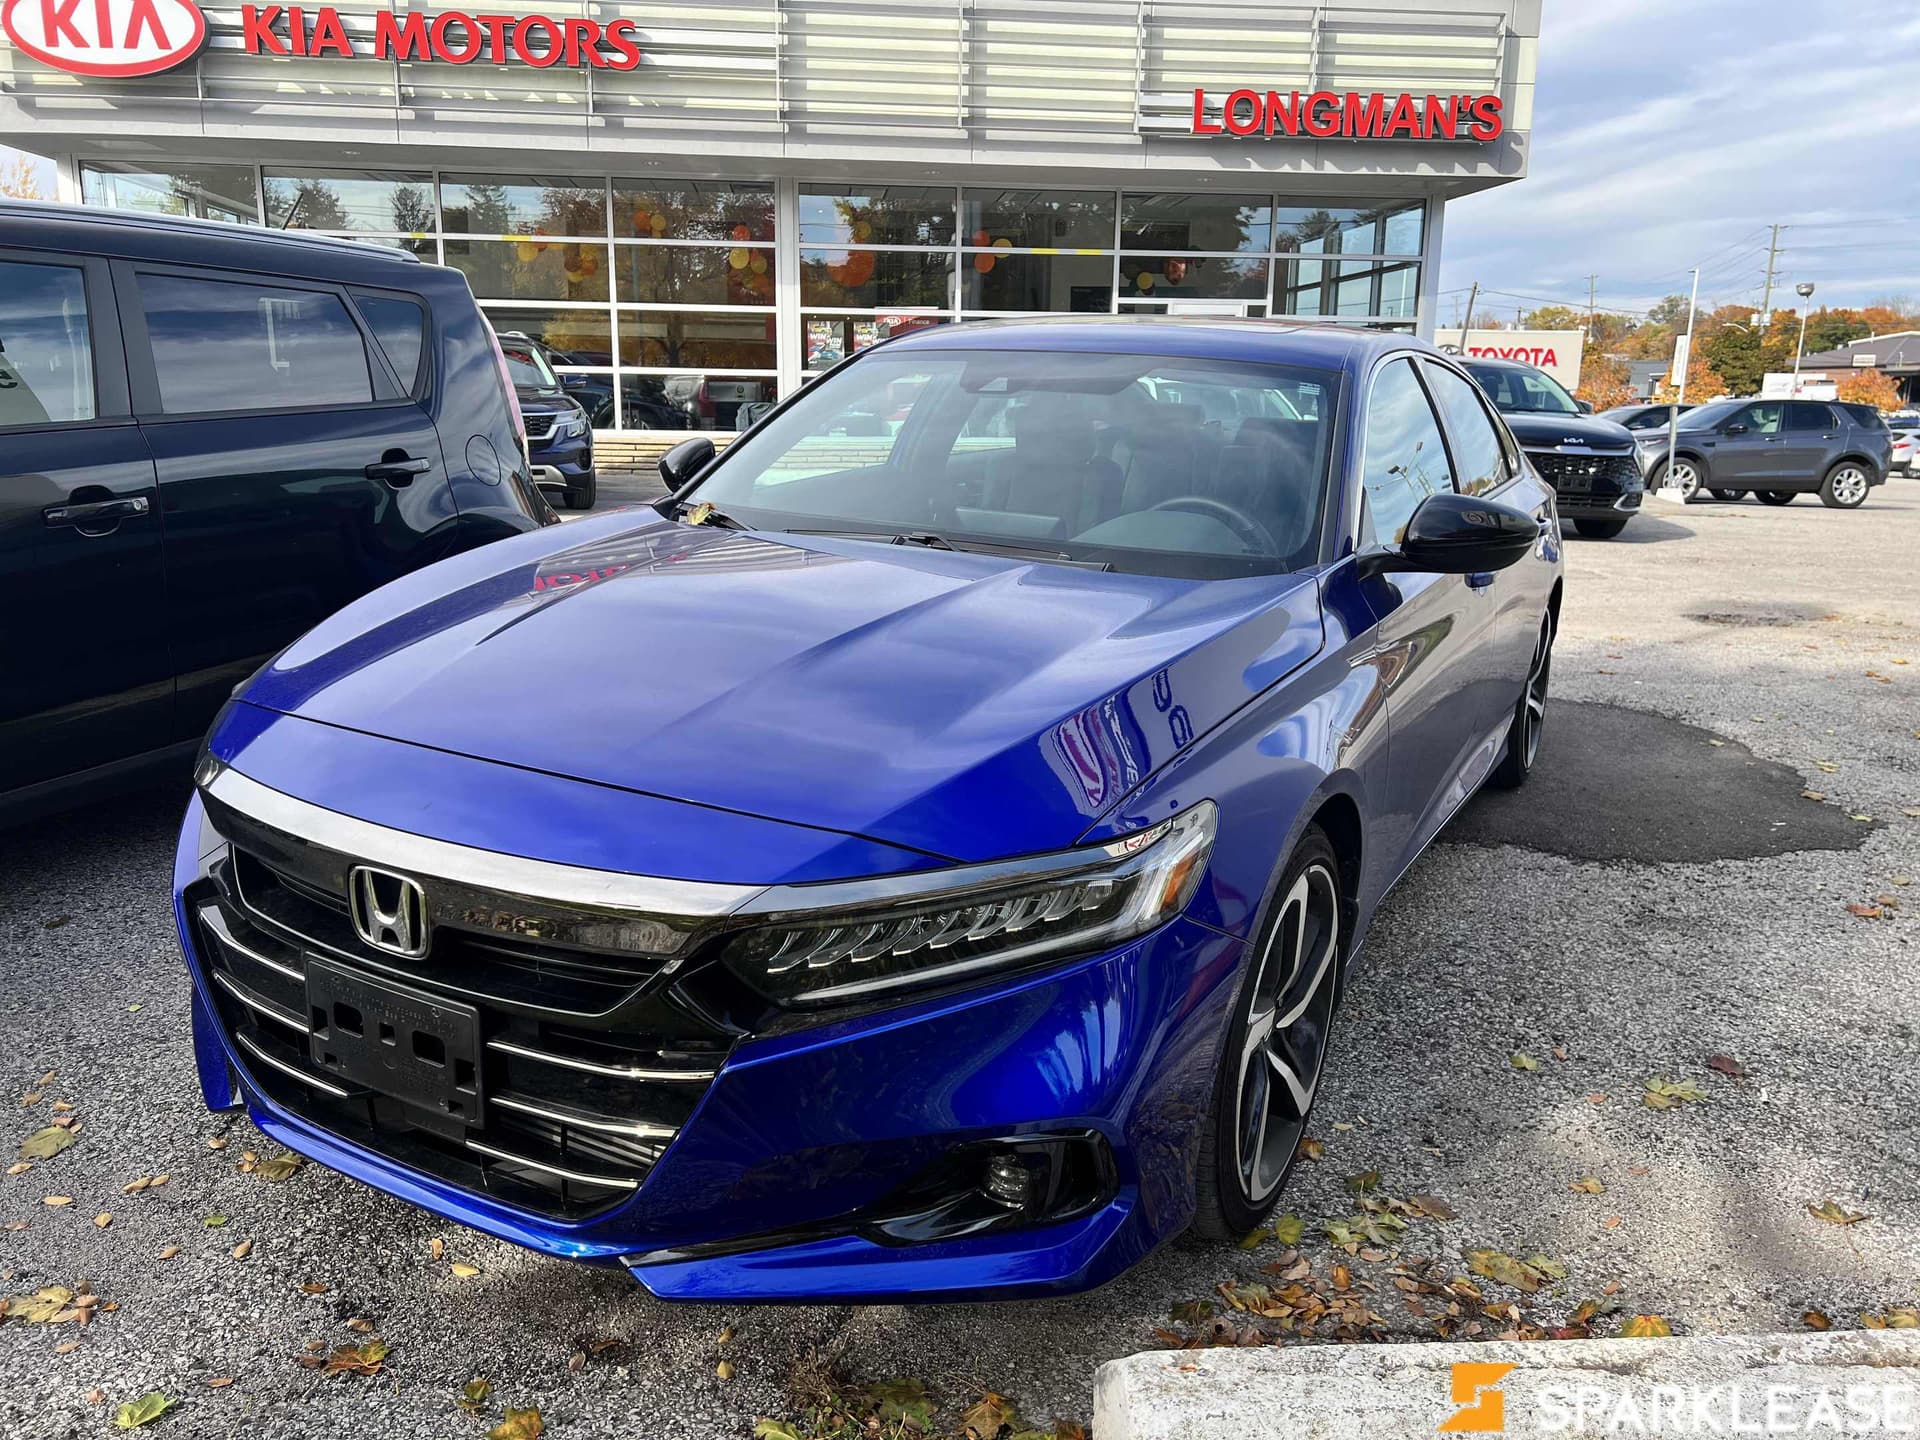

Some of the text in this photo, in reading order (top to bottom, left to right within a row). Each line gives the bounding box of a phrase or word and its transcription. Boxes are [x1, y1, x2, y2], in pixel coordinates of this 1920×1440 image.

[41, 0, 172, 50] KIA
[241, 4, 641, 70] KIA MOTORS
[1192, 88, 1503, 141] LONGMAN'S
[1468, 347, 1557, 367] TOYOTA
